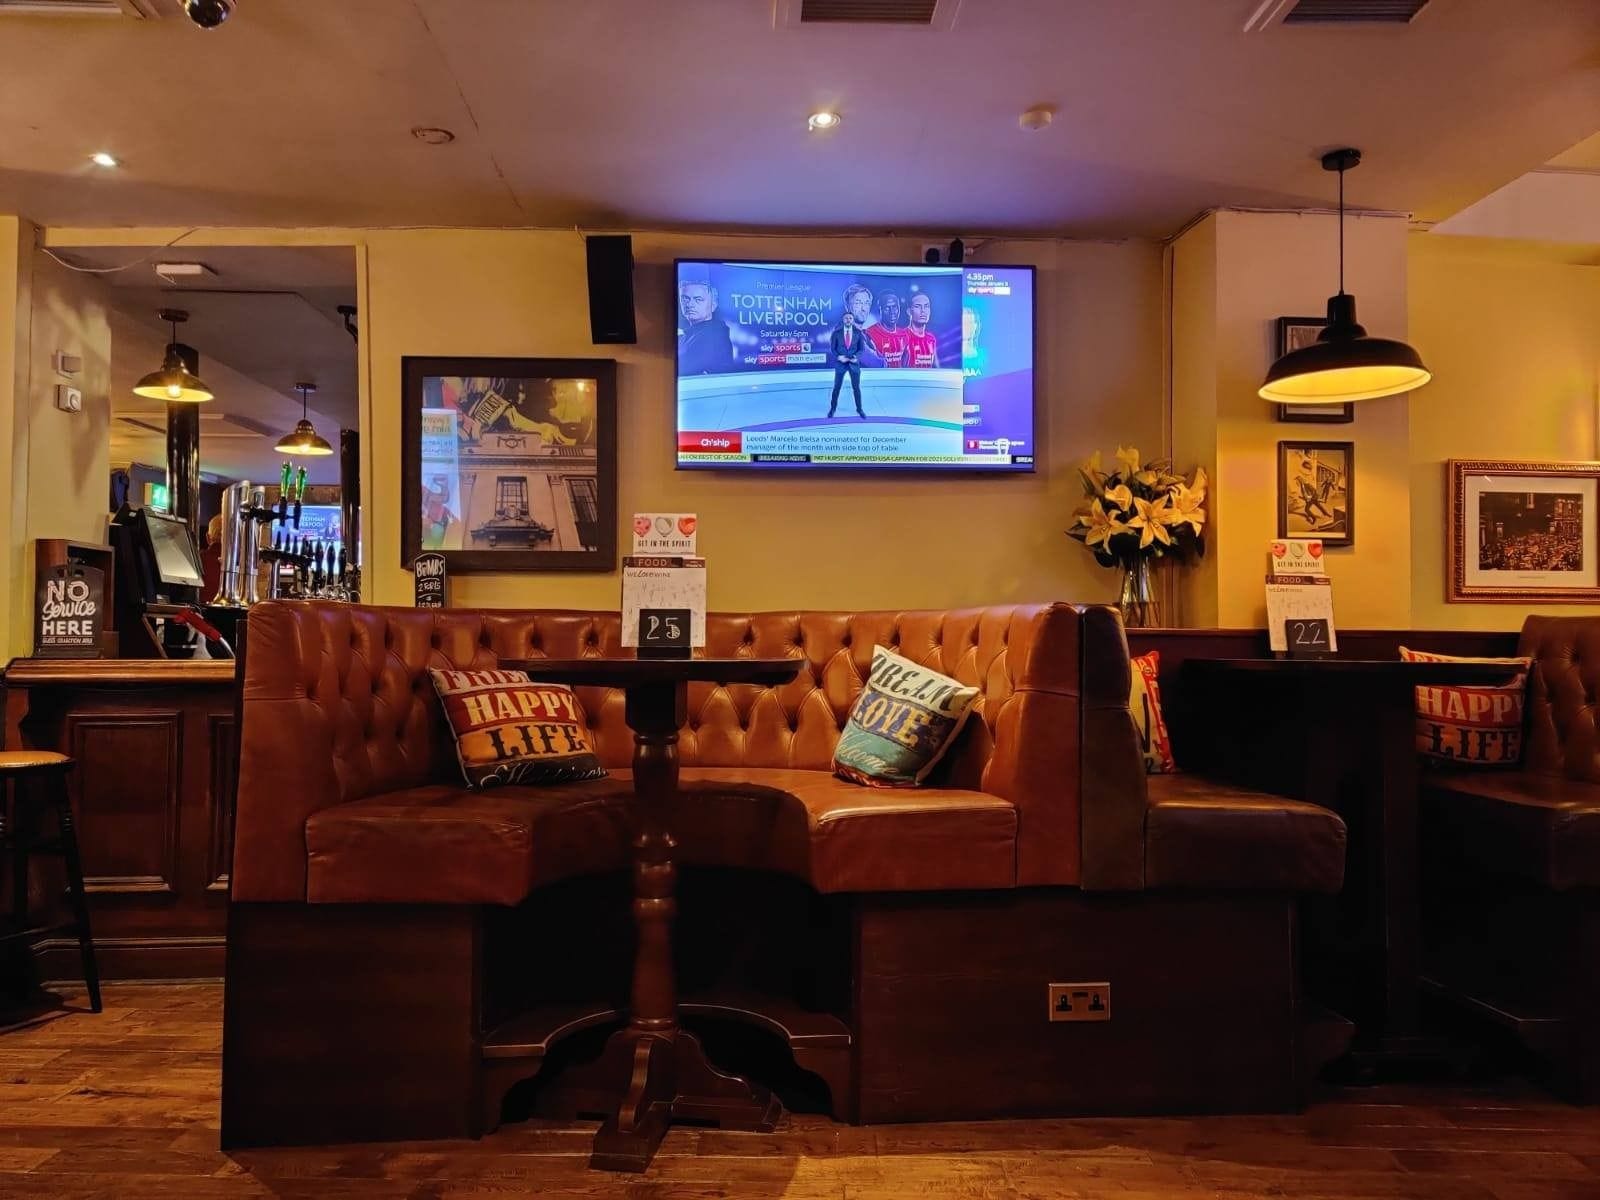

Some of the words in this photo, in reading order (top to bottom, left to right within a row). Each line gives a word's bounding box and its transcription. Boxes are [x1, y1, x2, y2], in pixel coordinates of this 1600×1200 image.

[731, 293, 832, 311] TOTTENHAM
[739, 311, 828, 326] LIVERPOOL
[760, 329, 793, 338] Saturday
[793, 330, 809, 338] 5pm
[760, 344, 774, 353] sky
[775, 344, 801, 353] sports
[744, 355, 757, 365] sky
[759, 355, 785, 364] sports
[701, 438, 730, 448] Ch'ship
[746, 435, 769, 443] Leeds'
[770, 435, 798, 443] Marcelo
[746, 444, 776, 452] manager
[858, 445, 871, 453] top
[638, 540, 648, 548] GET
[650, 540, 658, 548] IN
[659, 540, 670, 548] THE
[672, 540, 692, 548] SPIRIT
[416, 559, 444, 578] BOMBS
[638, 558, 668, 567] FOOD
[47, 579, 90, 602] NO
[42, 600, 96, 621] Service
[42, 620, 93, 636] HERE
[646, 615, 681, 640] 25
[1294, 622, 1326, 644] 22
[462, 690, 578, 726] HAPPY
[486, 724, 587, 759] LIFE
[1428, 723, 1518, 761] LIFE
